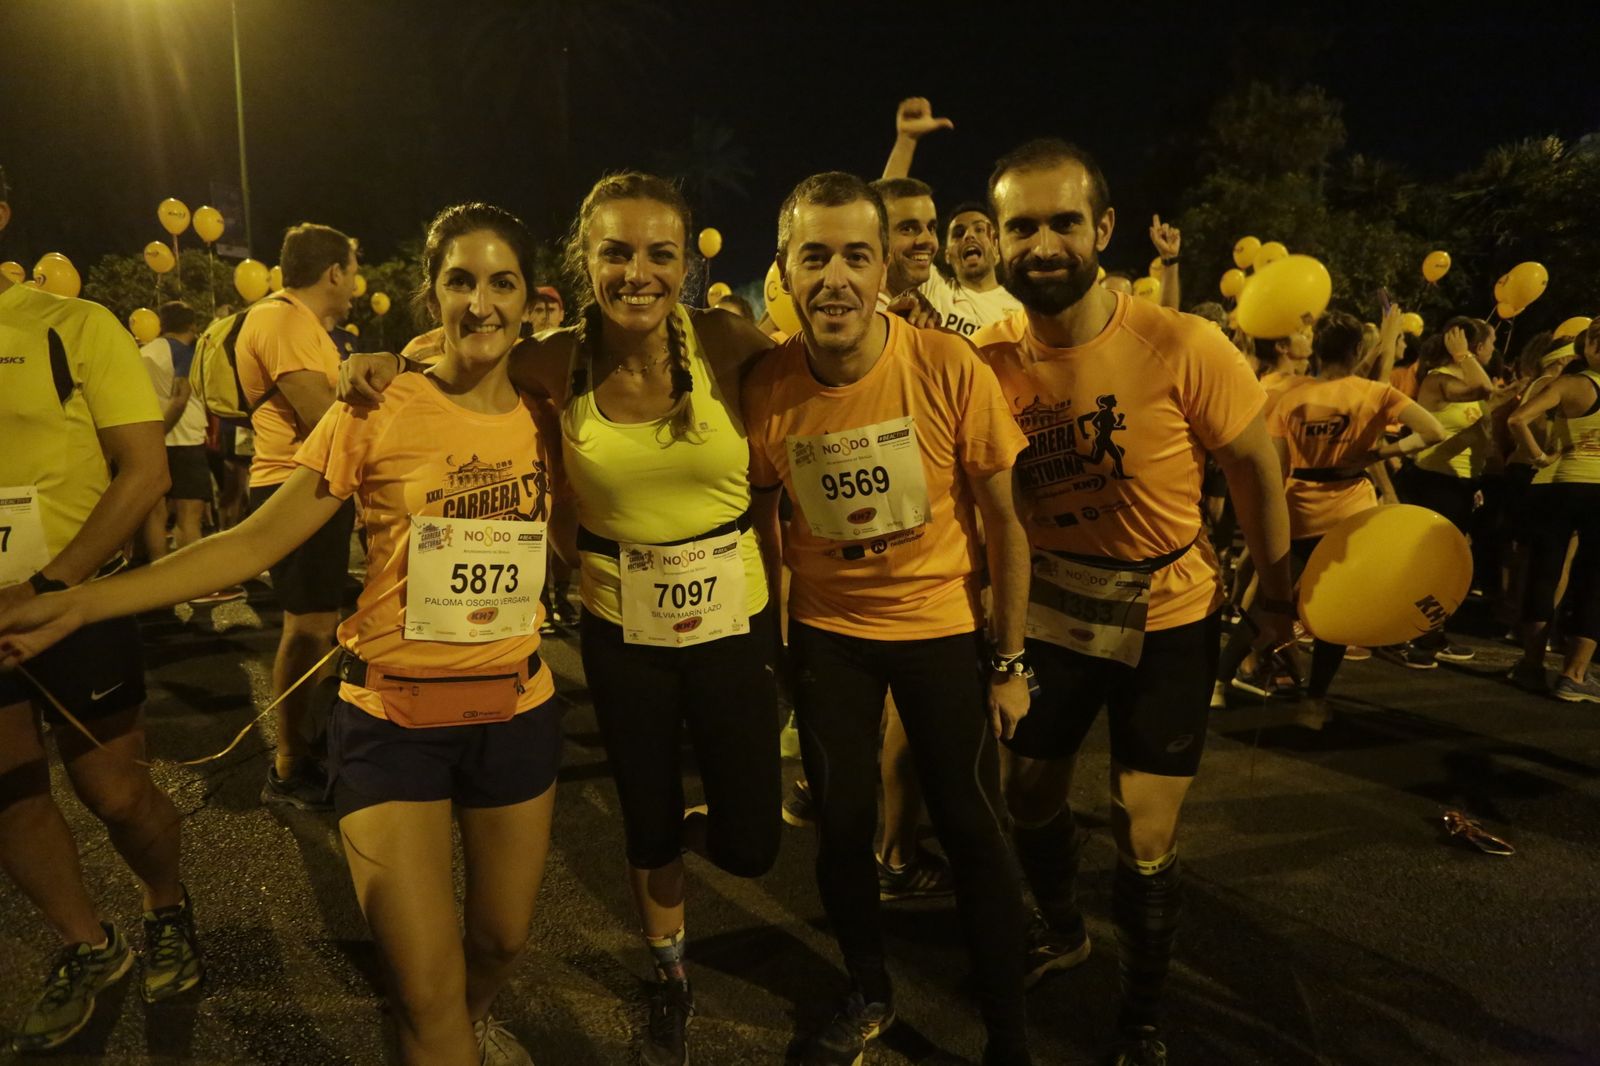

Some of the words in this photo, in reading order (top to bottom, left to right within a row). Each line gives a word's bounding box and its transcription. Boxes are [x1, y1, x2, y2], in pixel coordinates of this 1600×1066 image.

[944, 313, 981, 337] Pla
[426, 488, 443, 504] XXXI
[821, 466, 890, 501] 9569
[443, 482, 520, 519] CARRERA
[450, 563, 518, 594] 5873
[654, 576, 717, 609] 7097
[425, 597, 462, 606] PALOMA
[465, 598, 499, 607] OSORIO
[500, 596, 530, 605] VERGARA
[651, 611, 676, 619] SILVIA
[703, 603, 722, 615] LAZO
[1057, 591, 1114, 623] 1353
[1413, 593, 1446, 622] KH
